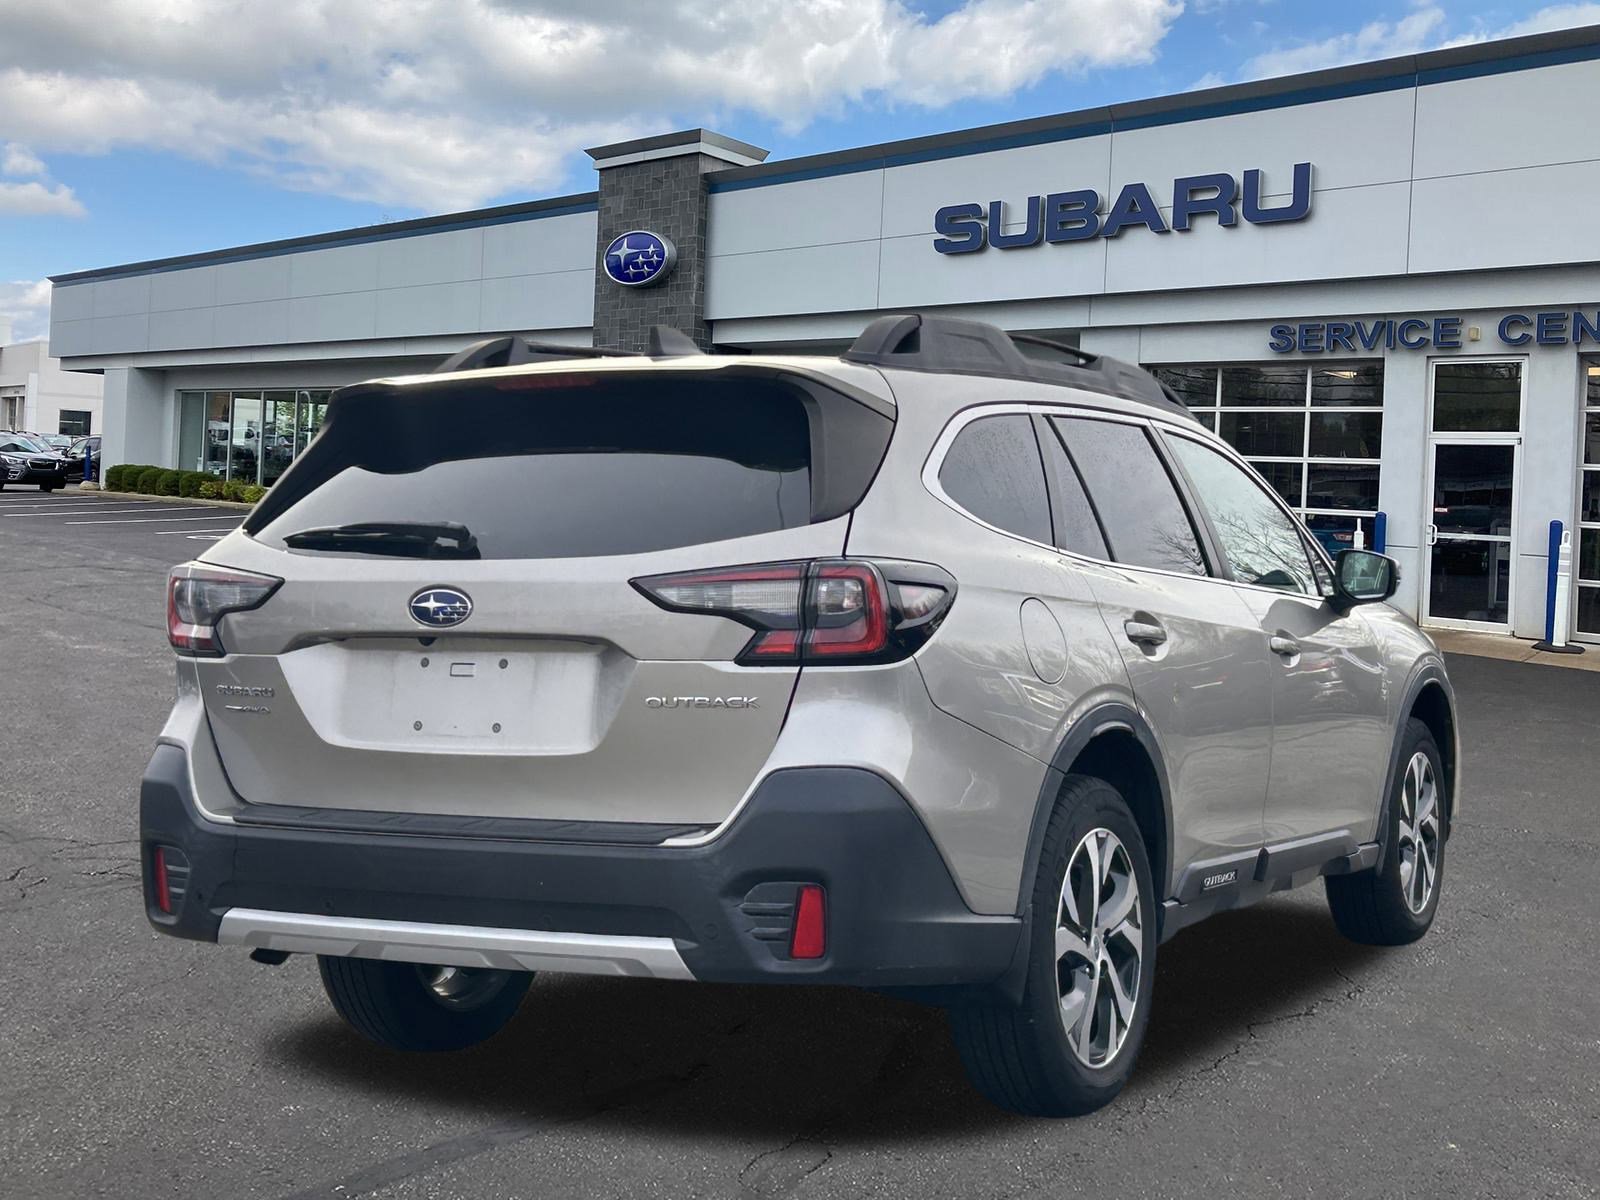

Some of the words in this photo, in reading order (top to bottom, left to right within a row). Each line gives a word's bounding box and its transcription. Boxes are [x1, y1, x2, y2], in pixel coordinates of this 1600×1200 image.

[933, 161, 1313, 255] SUBARU
[1268, 316, 1464, 352] SERVICE
[1497, 310, 1600, 346] CEN
[645, 695, 760, 709] OUTBACK
[1203, 870, 1237, 887] OUTBACK
